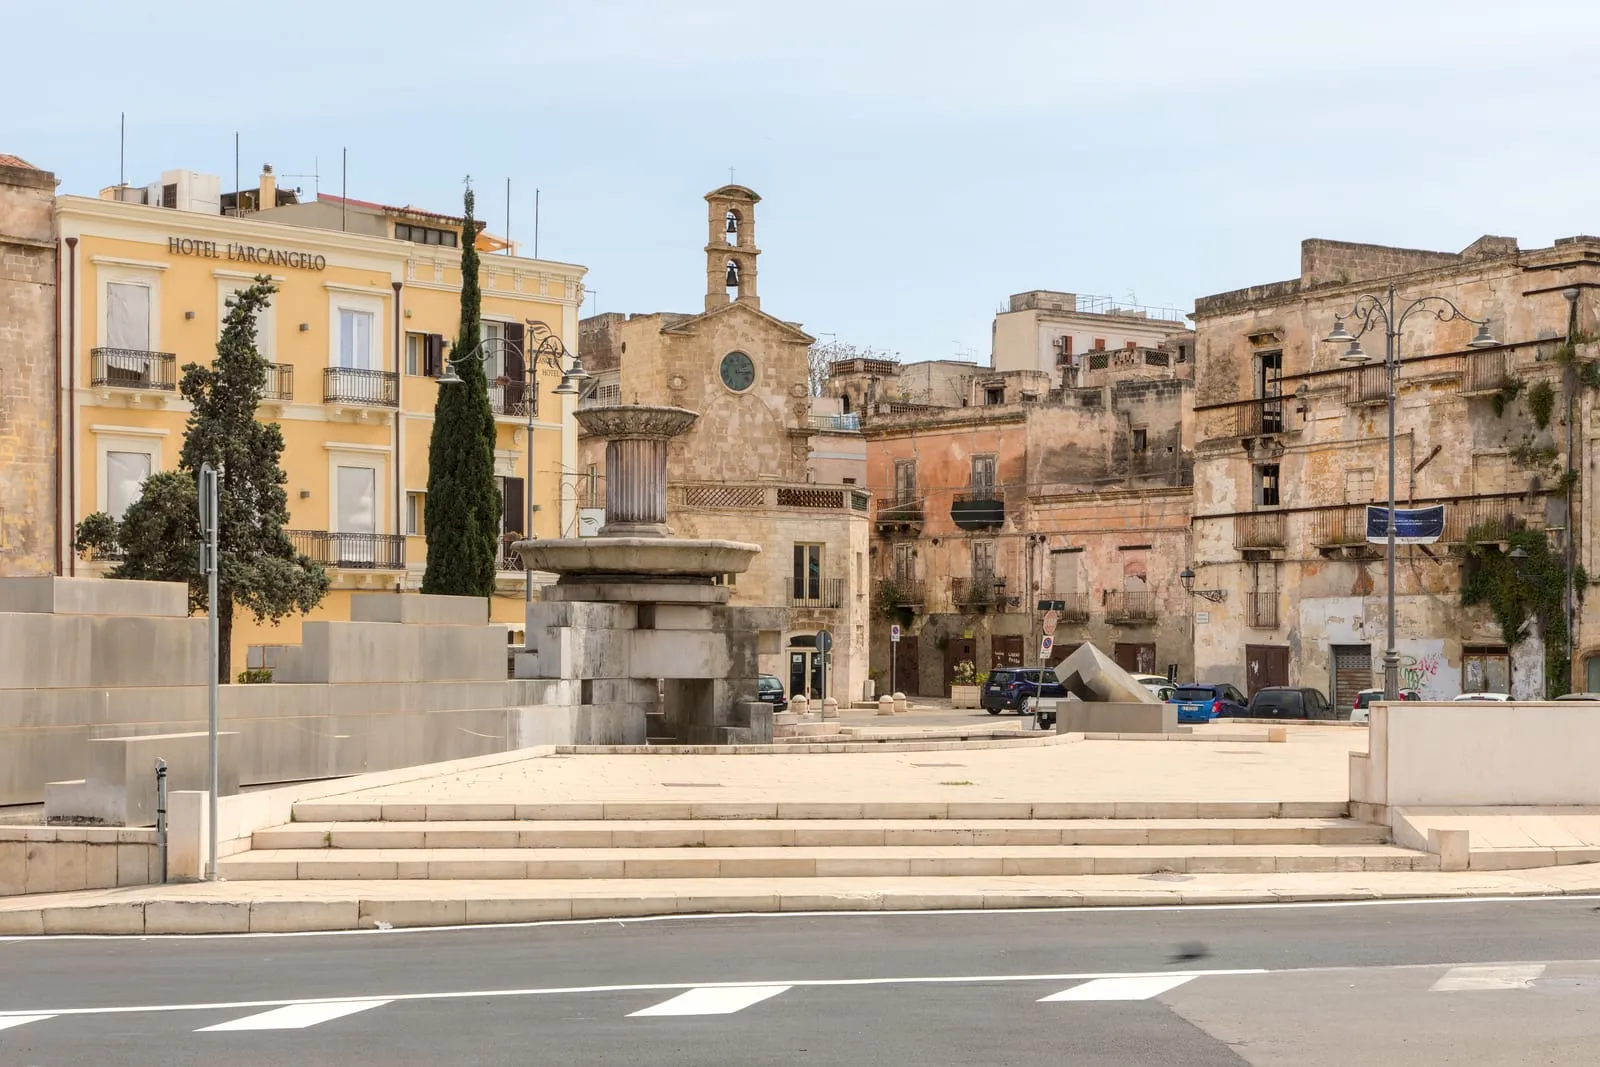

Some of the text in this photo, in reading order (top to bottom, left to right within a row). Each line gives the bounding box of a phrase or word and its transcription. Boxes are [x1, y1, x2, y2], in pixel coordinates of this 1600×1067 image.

[168, 236, 326, 271] HOTEL L'ARCANGELO
[542, 369, 559, 377] HOTEL
